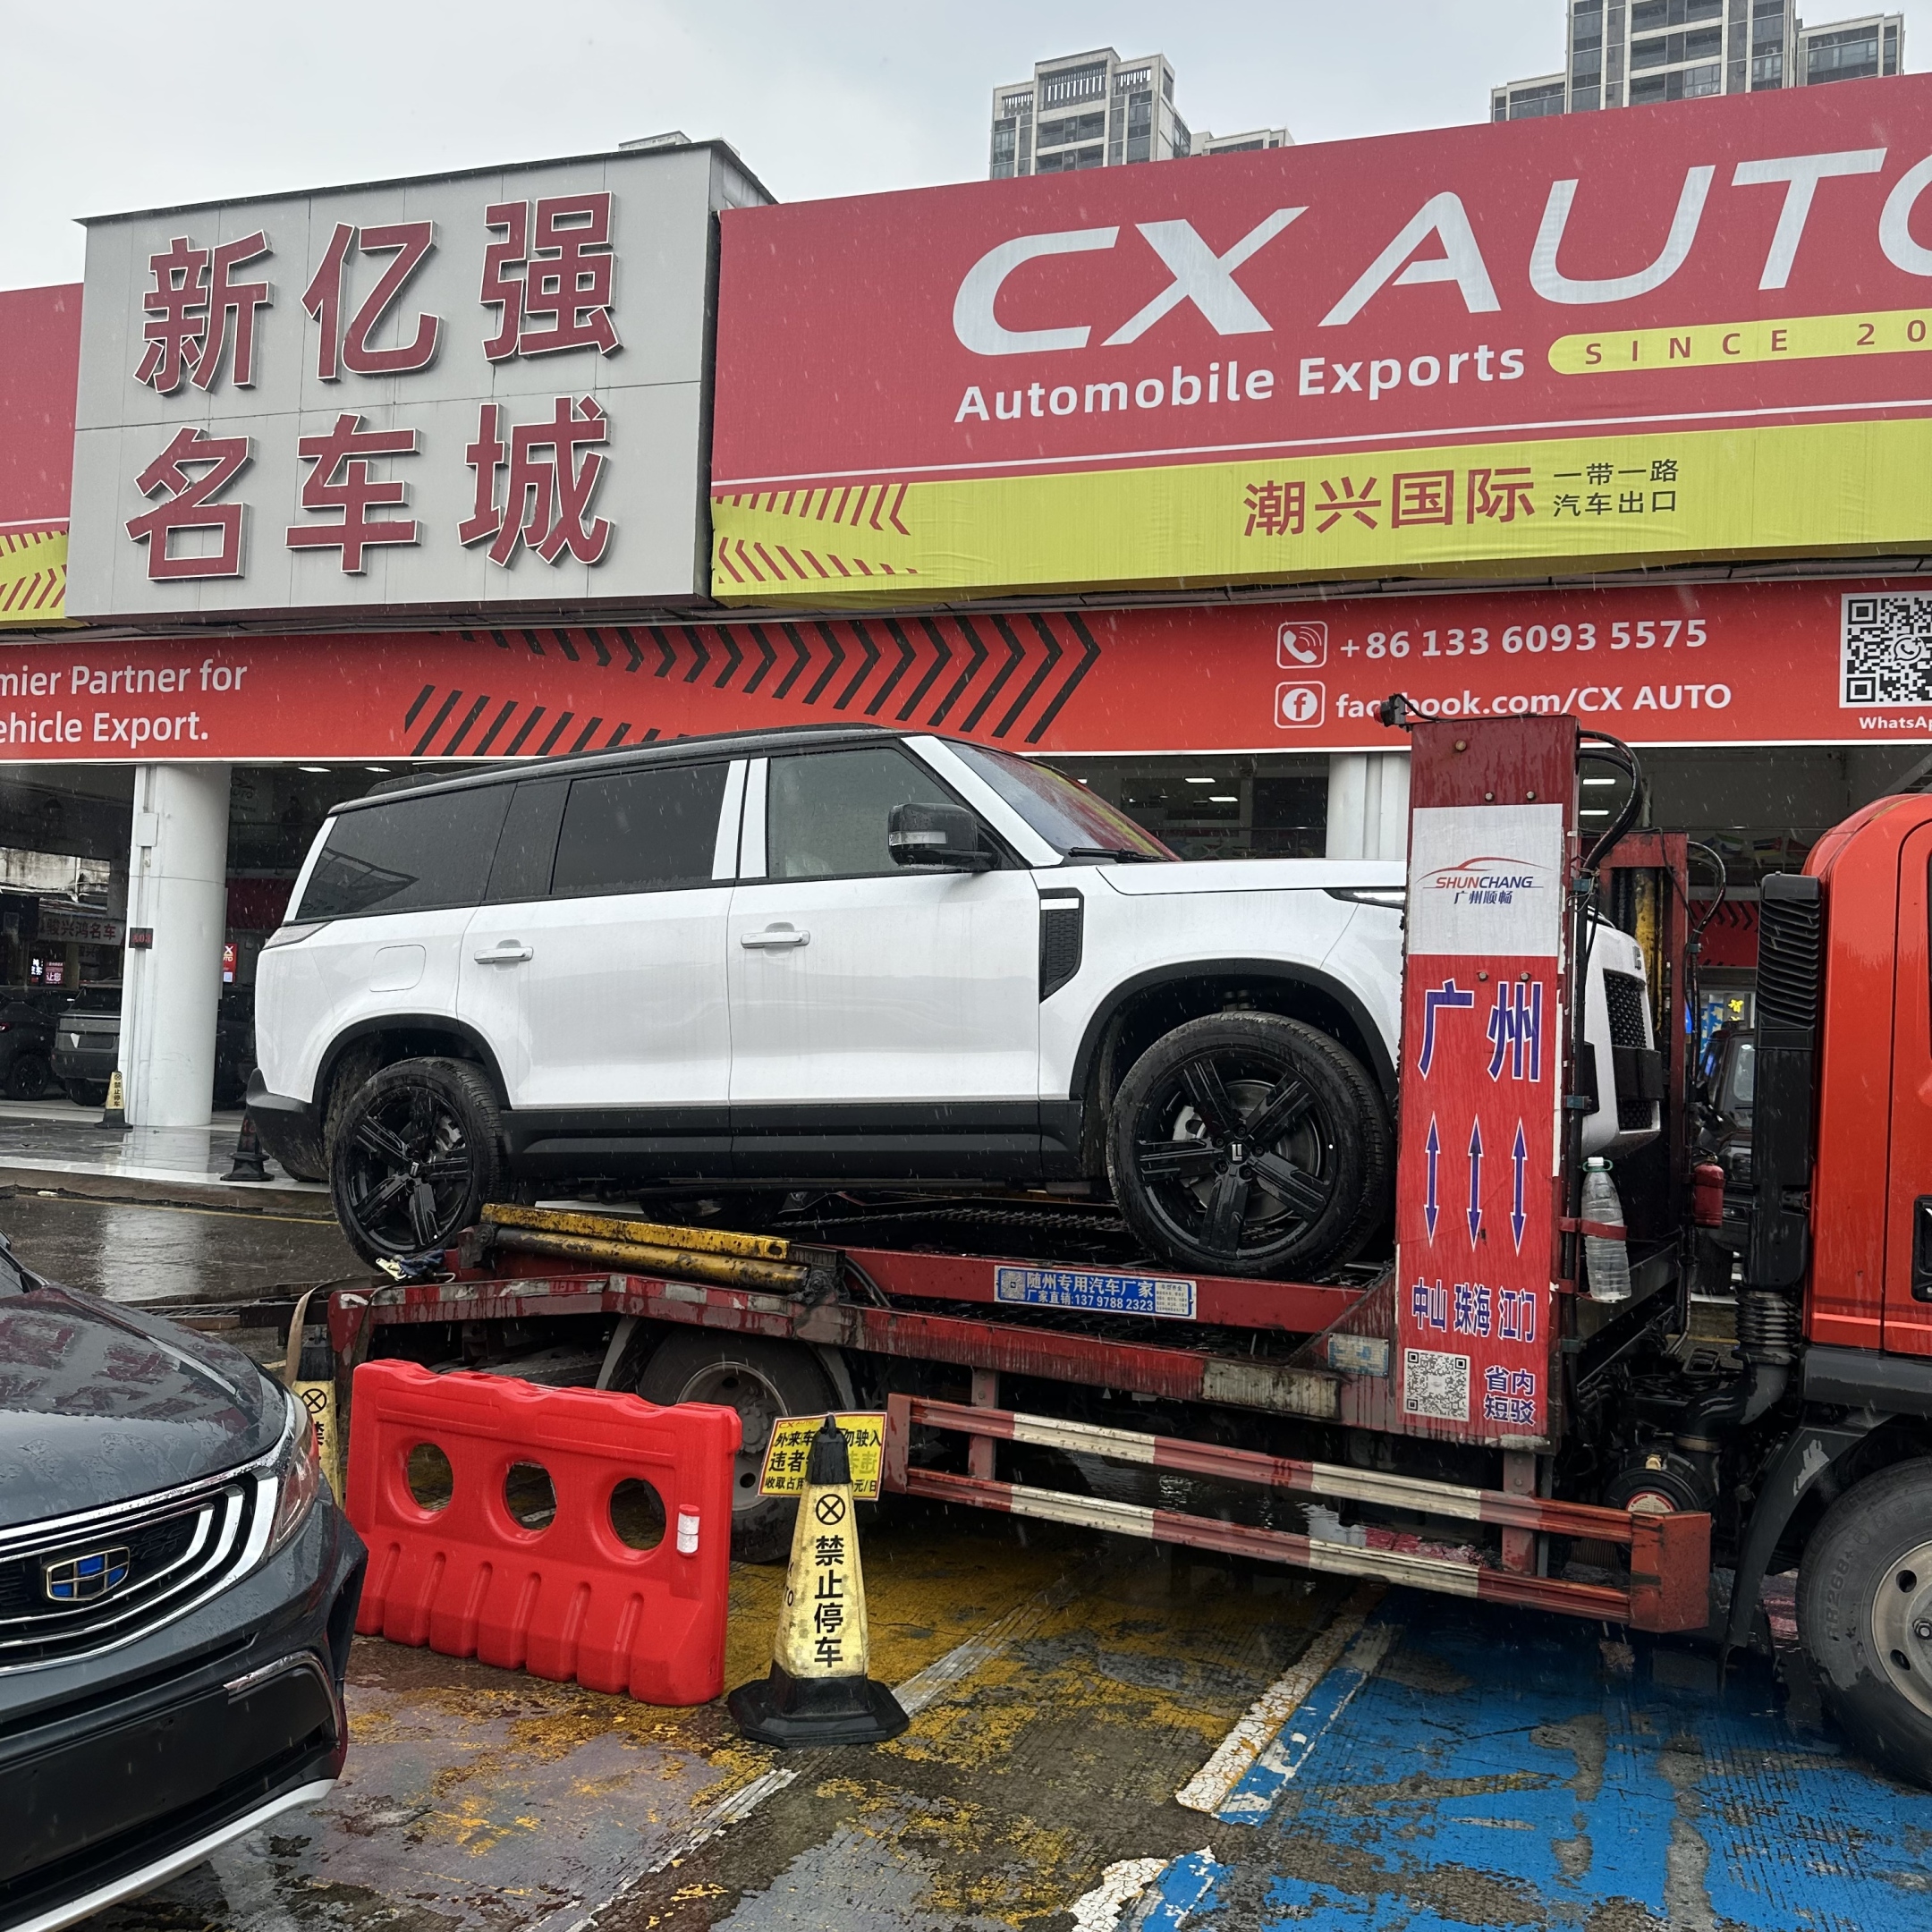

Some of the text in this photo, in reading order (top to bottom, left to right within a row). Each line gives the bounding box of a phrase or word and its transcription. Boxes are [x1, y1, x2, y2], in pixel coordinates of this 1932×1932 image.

[133, 191, 623, 395] 新亿强
[953, 206, 1309, 356] CX
[1585, 319, 1927, 365] SINCE 20
[953, 343, 1526, 423] Automobile Exports
[124, 394, 614, 581] 名车城
[1553, 459, 1680, 487] 一带一路
[1242, 466, 1537, 538] 潮兴国际
[1553, 489, 1678, 518] 汽车出口
[1340, 619, 1707, 660] +86 133 6093 5575
[71, 665, 191, 695] Partner
[199, 658, 248, 691] for
[1335, 683, 1733, 718] facbook.com/CX AUTO
[93, 711, 208, 750] Export.
[1436, 876, 1534, 889] SHUNCHANG
[1453, 890, 1513, 905] 广州顺畅
[1417, 978, 1543, 1083] 广州
[1097, 1296, 1123, 1309] 9788
[1126, 1299, 1154, 1312] 2323
[1411, 1277, 1537, 1343] 中山 珠海 江门
[1484, 1365, 1536, 1396] 省内
[1483, 1394, 1537, 1427] 短驳
[814, 1534, 845, 1668] 禁止停车
